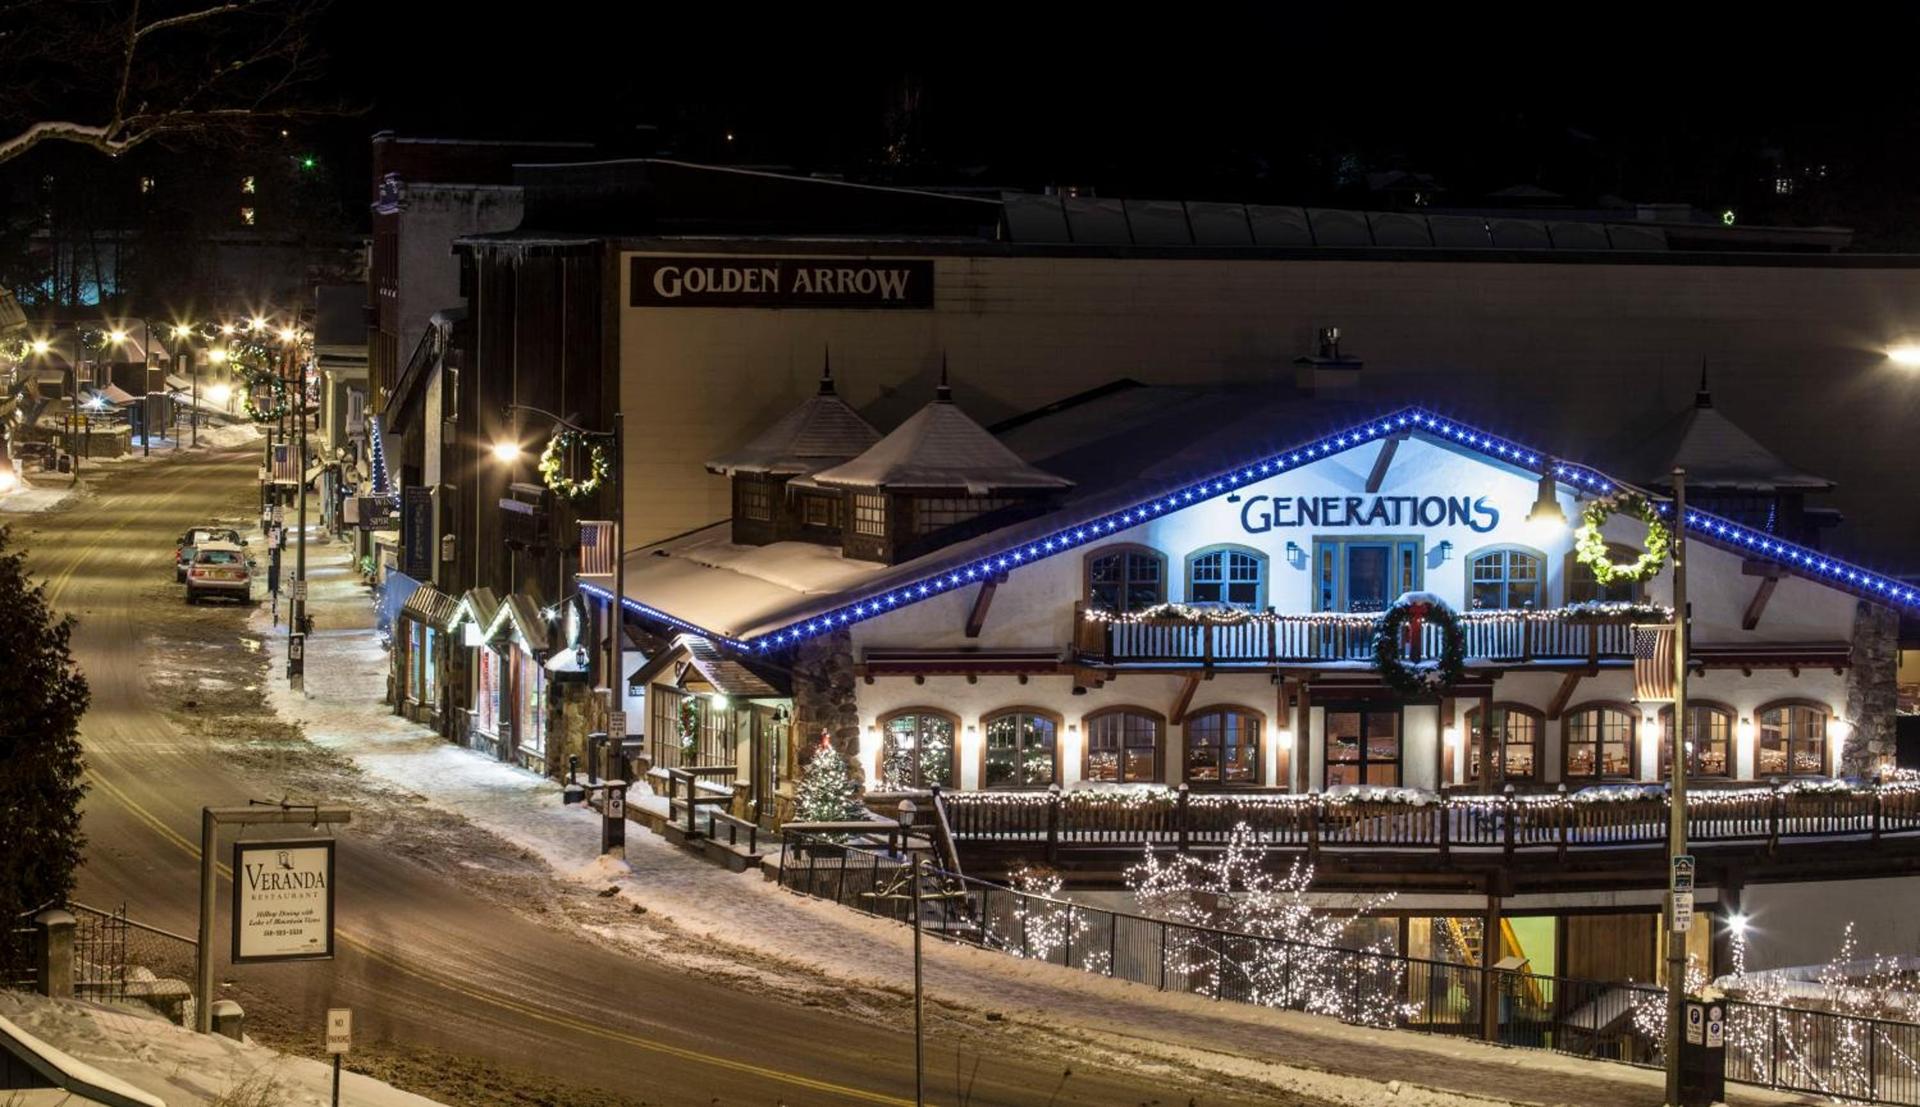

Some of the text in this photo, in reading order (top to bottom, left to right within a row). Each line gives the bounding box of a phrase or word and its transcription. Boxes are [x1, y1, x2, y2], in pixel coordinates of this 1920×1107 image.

[652, 266, 911, 300] GOLDEN ARROW
[1240, 494, 1500, 534] GENERATIONS
[245, 862, 326, 891] VERANDA
[251, 891, 319, 901] RESTAURANT
[279, 910, 300, 918] Dining
[248, 918, 265, 926] Lake
[273, 917, 303, 925] Mountain
[335, 1018, 344, 1027] NO
